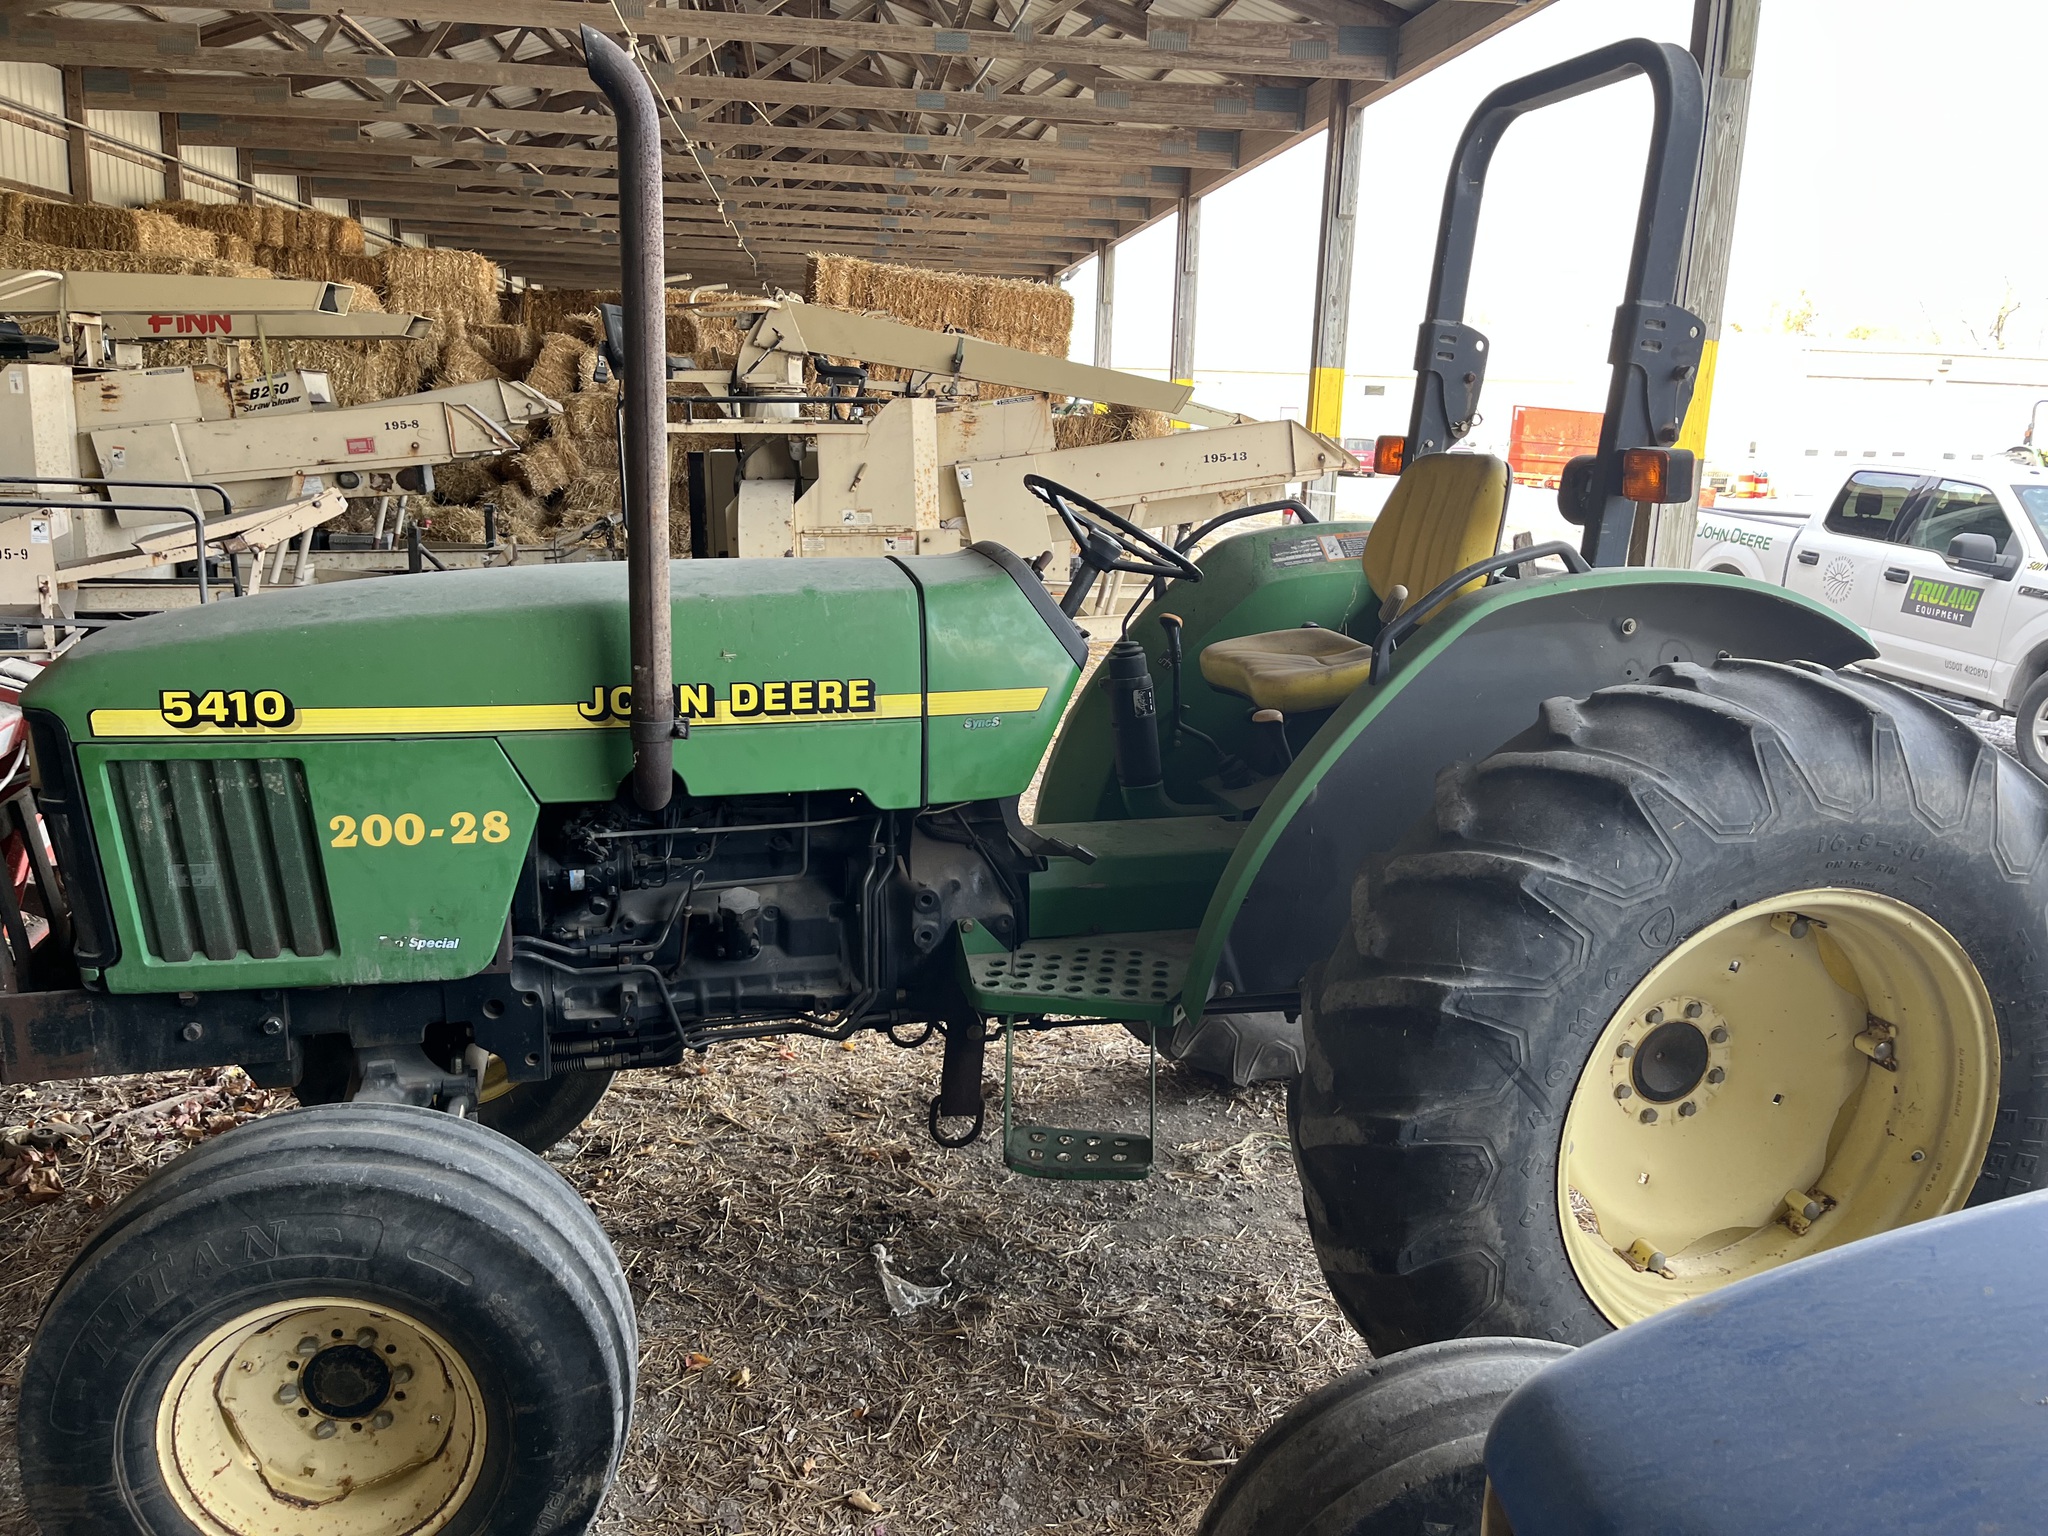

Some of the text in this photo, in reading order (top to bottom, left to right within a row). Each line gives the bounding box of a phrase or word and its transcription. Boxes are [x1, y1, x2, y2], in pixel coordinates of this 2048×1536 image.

[243, 401, 271, 412] Straw
[384, 419, 420, 431] 195-8
[1203, 451, 1248, 464] 195-13
[1696, 522, 1773, 551] JOHN DEERE
[0, 548, 28, 560] 5-9
[1910, 579, 1980, 612] TRULAND
[1915, 604, 1965, 622] EQUIPMENT
[1944, 660, 1963, 672] USDOT
[160, 690, 291, 727] 5410
[578, 679, 873, 719] JON DEERE
[329, 811, 511, 848] 200-28
[1817, 832, 1929, 862] 16.9-30
[408, 937, 460, 951] Special
[80, 1219, 288, 1369] TITAN
